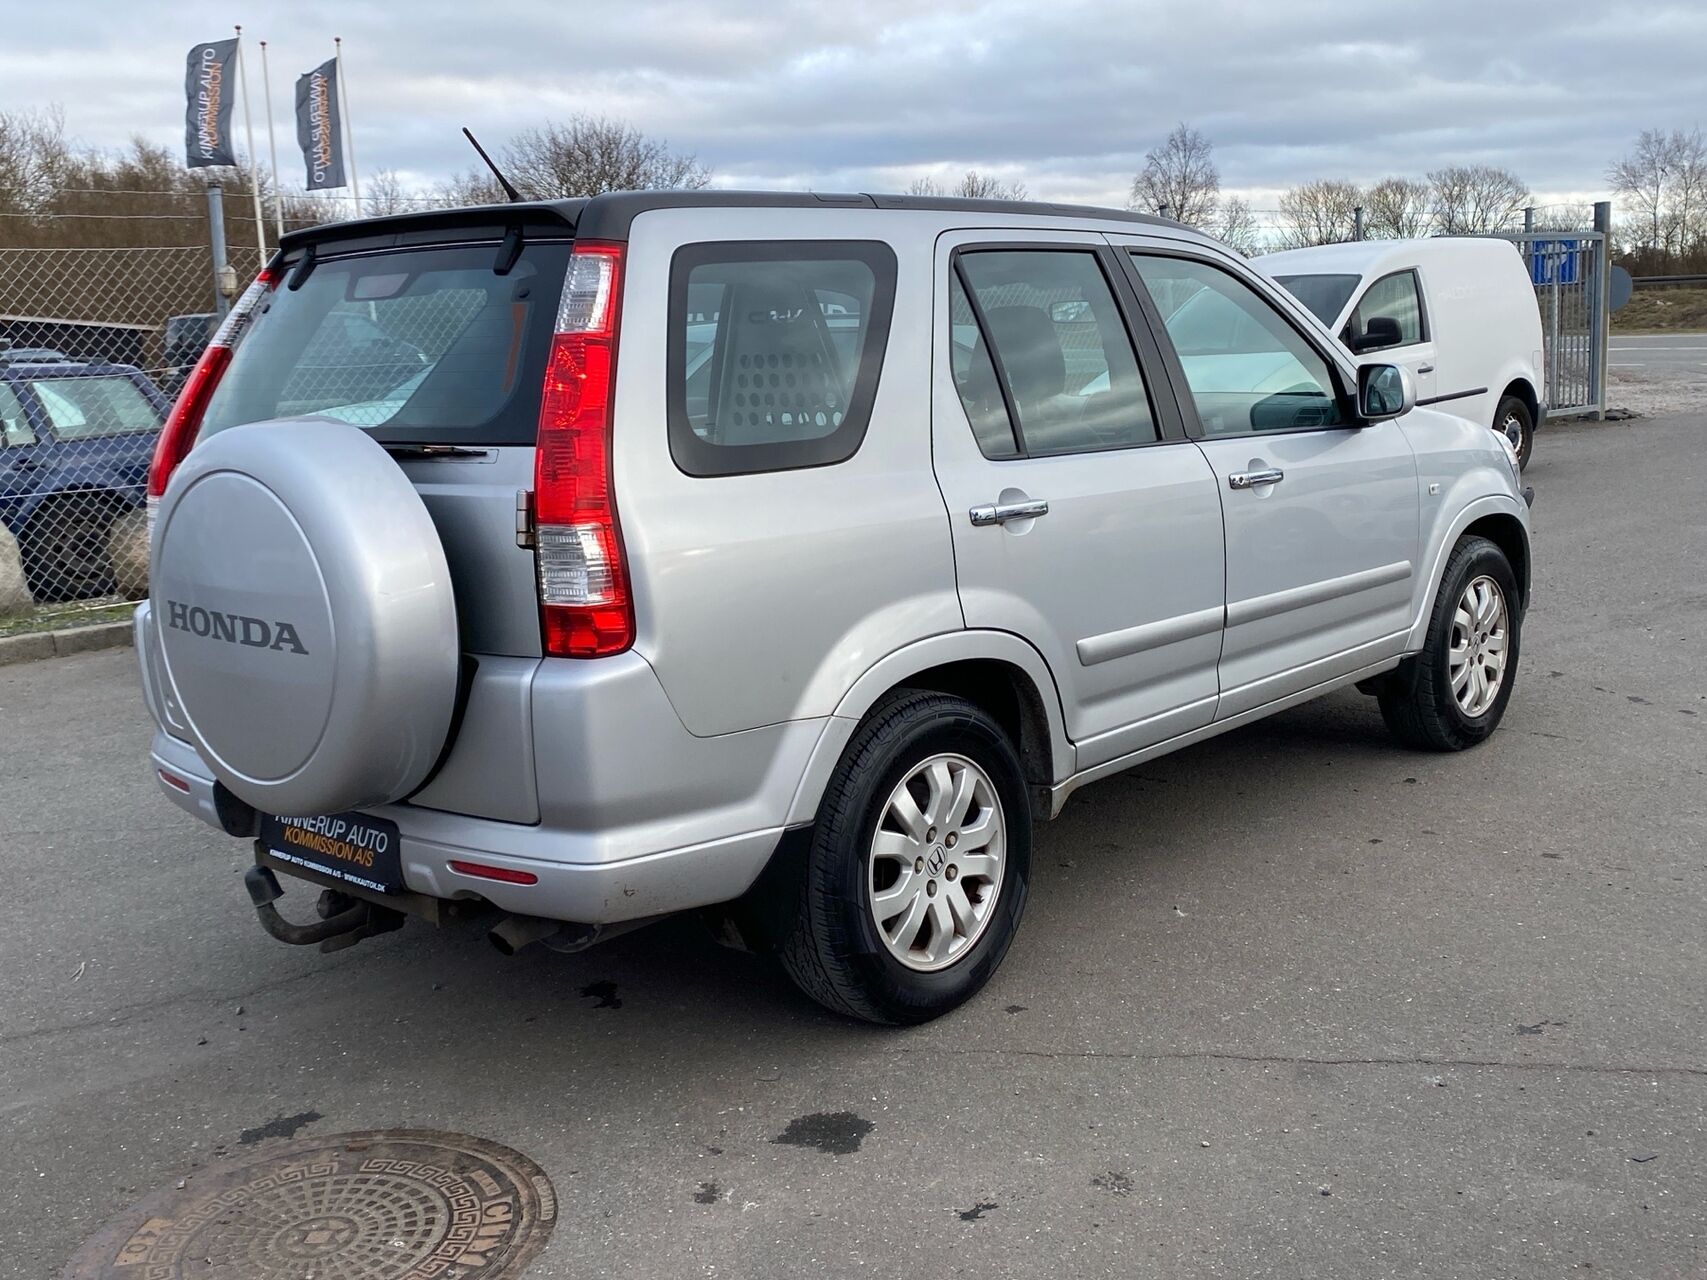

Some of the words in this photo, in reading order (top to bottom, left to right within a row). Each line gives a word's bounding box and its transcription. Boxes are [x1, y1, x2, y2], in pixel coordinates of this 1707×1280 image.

[200, 48, 215, 89] AUTO
[198, 91, 214, 159] KINNERUP
[207, 62, 222, 149] KOMMISSION
[168, 600, 309, 655] HONDA
[284, 826, 354, 860] KOMMISSION
[353, 847, 374, 867] A/S
[346, 824, 388, 853] AUTO
